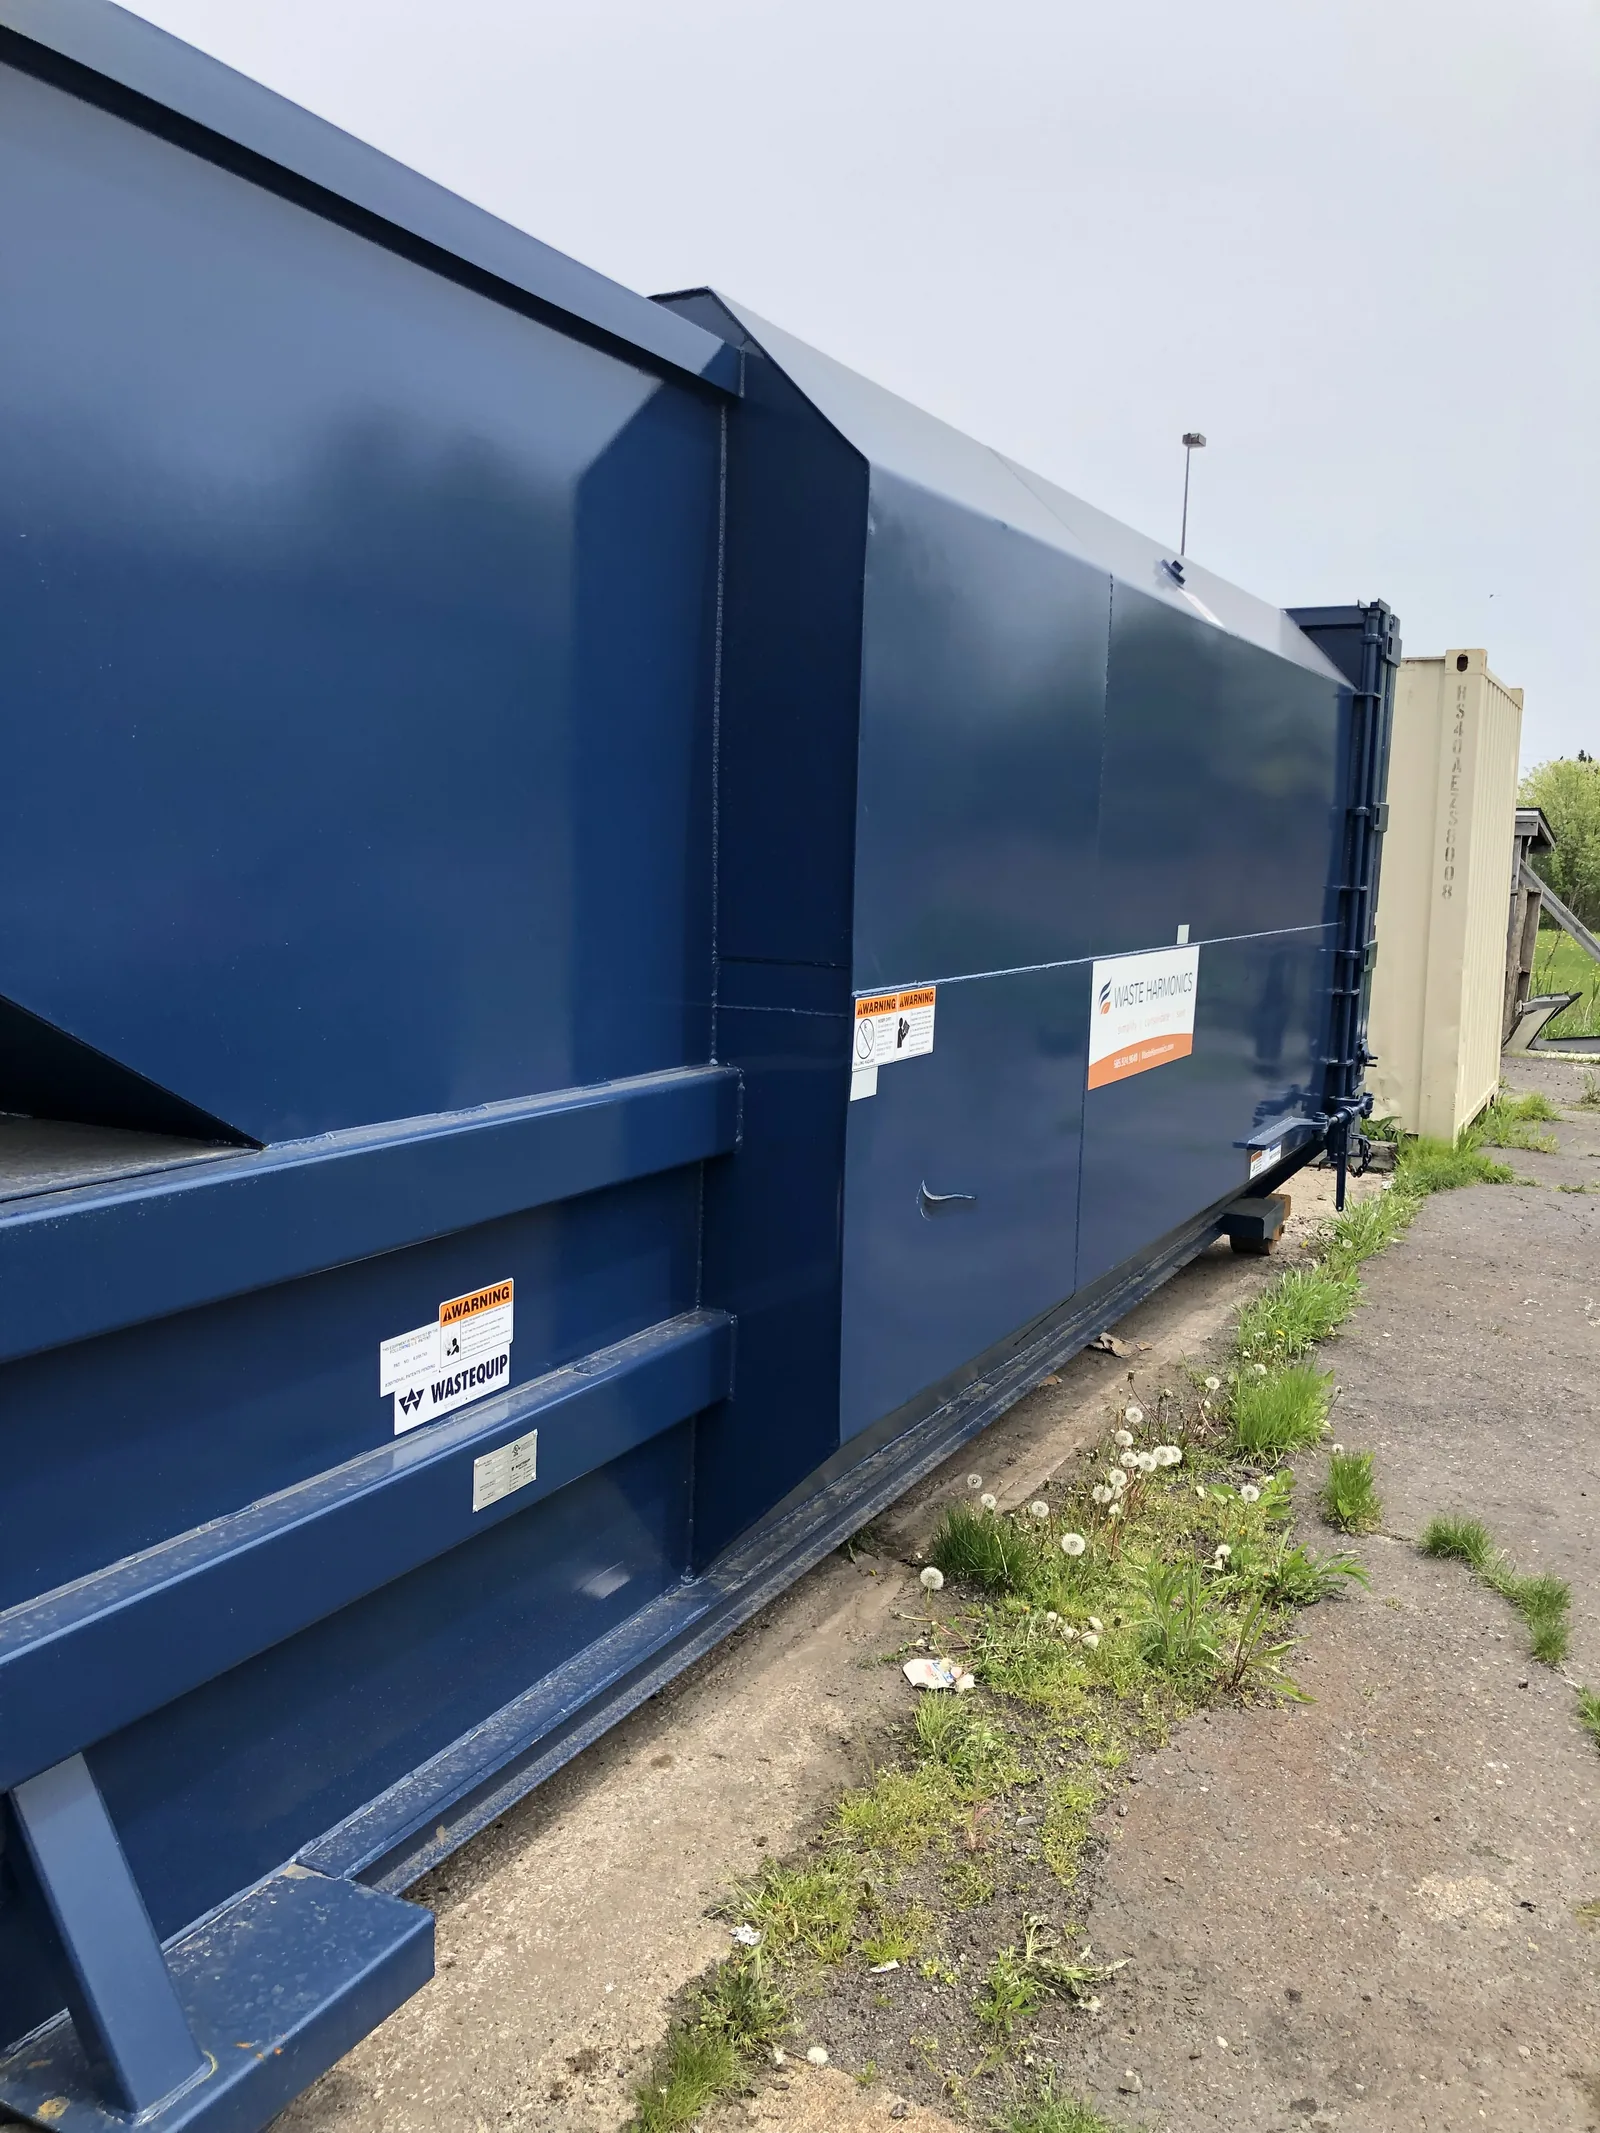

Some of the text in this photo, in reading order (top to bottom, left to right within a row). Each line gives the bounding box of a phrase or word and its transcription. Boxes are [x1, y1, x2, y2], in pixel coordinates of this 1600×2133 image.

[862, 998, 896, 1014] WARNING
[903, 992, 934, 1008] WARNING
[1114, 972, 1193, 1009] WASTE HARMONICS
[451, 1286, 510, 1319] WARNING
[430, 1353, 508, 1404] WASTEQUIP
